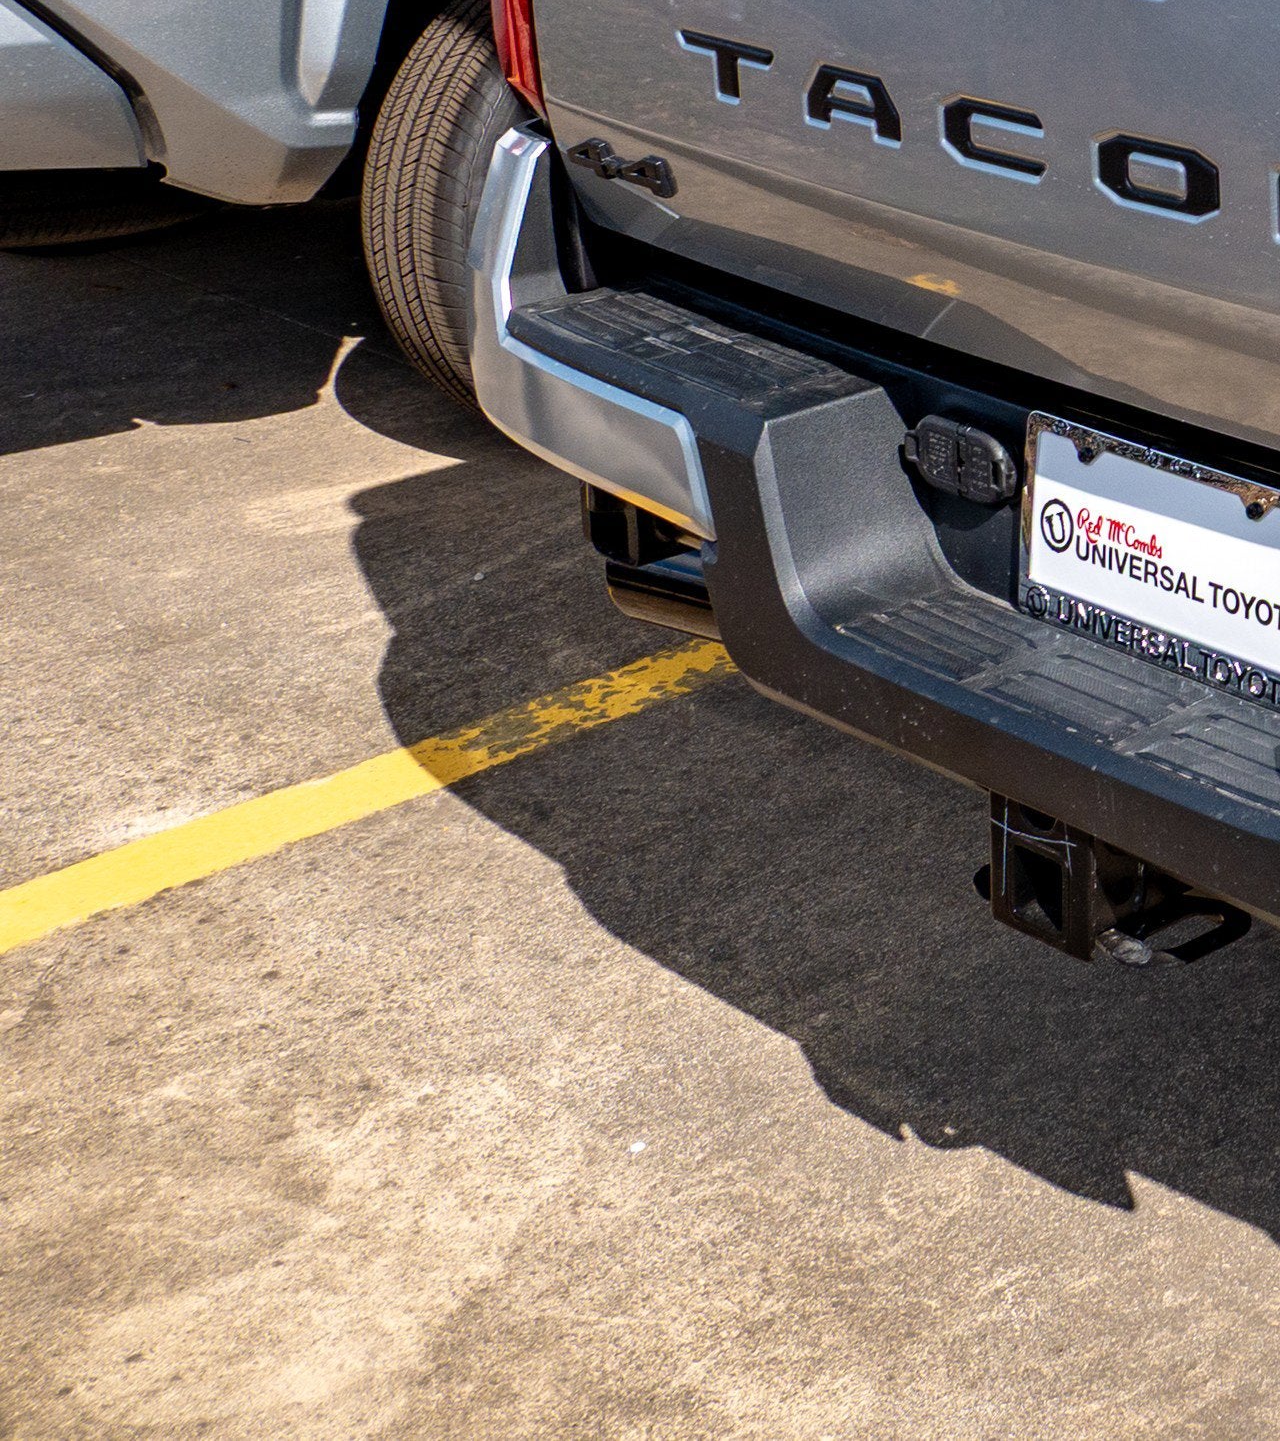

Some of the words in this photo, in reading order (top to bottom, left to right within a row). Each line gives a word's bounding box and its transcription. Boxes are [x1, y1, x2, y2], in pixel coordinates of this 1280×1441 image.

[1077, 507, 1103, 545] Red
[1076, 536, 1203, 603] UNIVERSAL
[1057, 594, 1197, 673] UNIVERSAL
